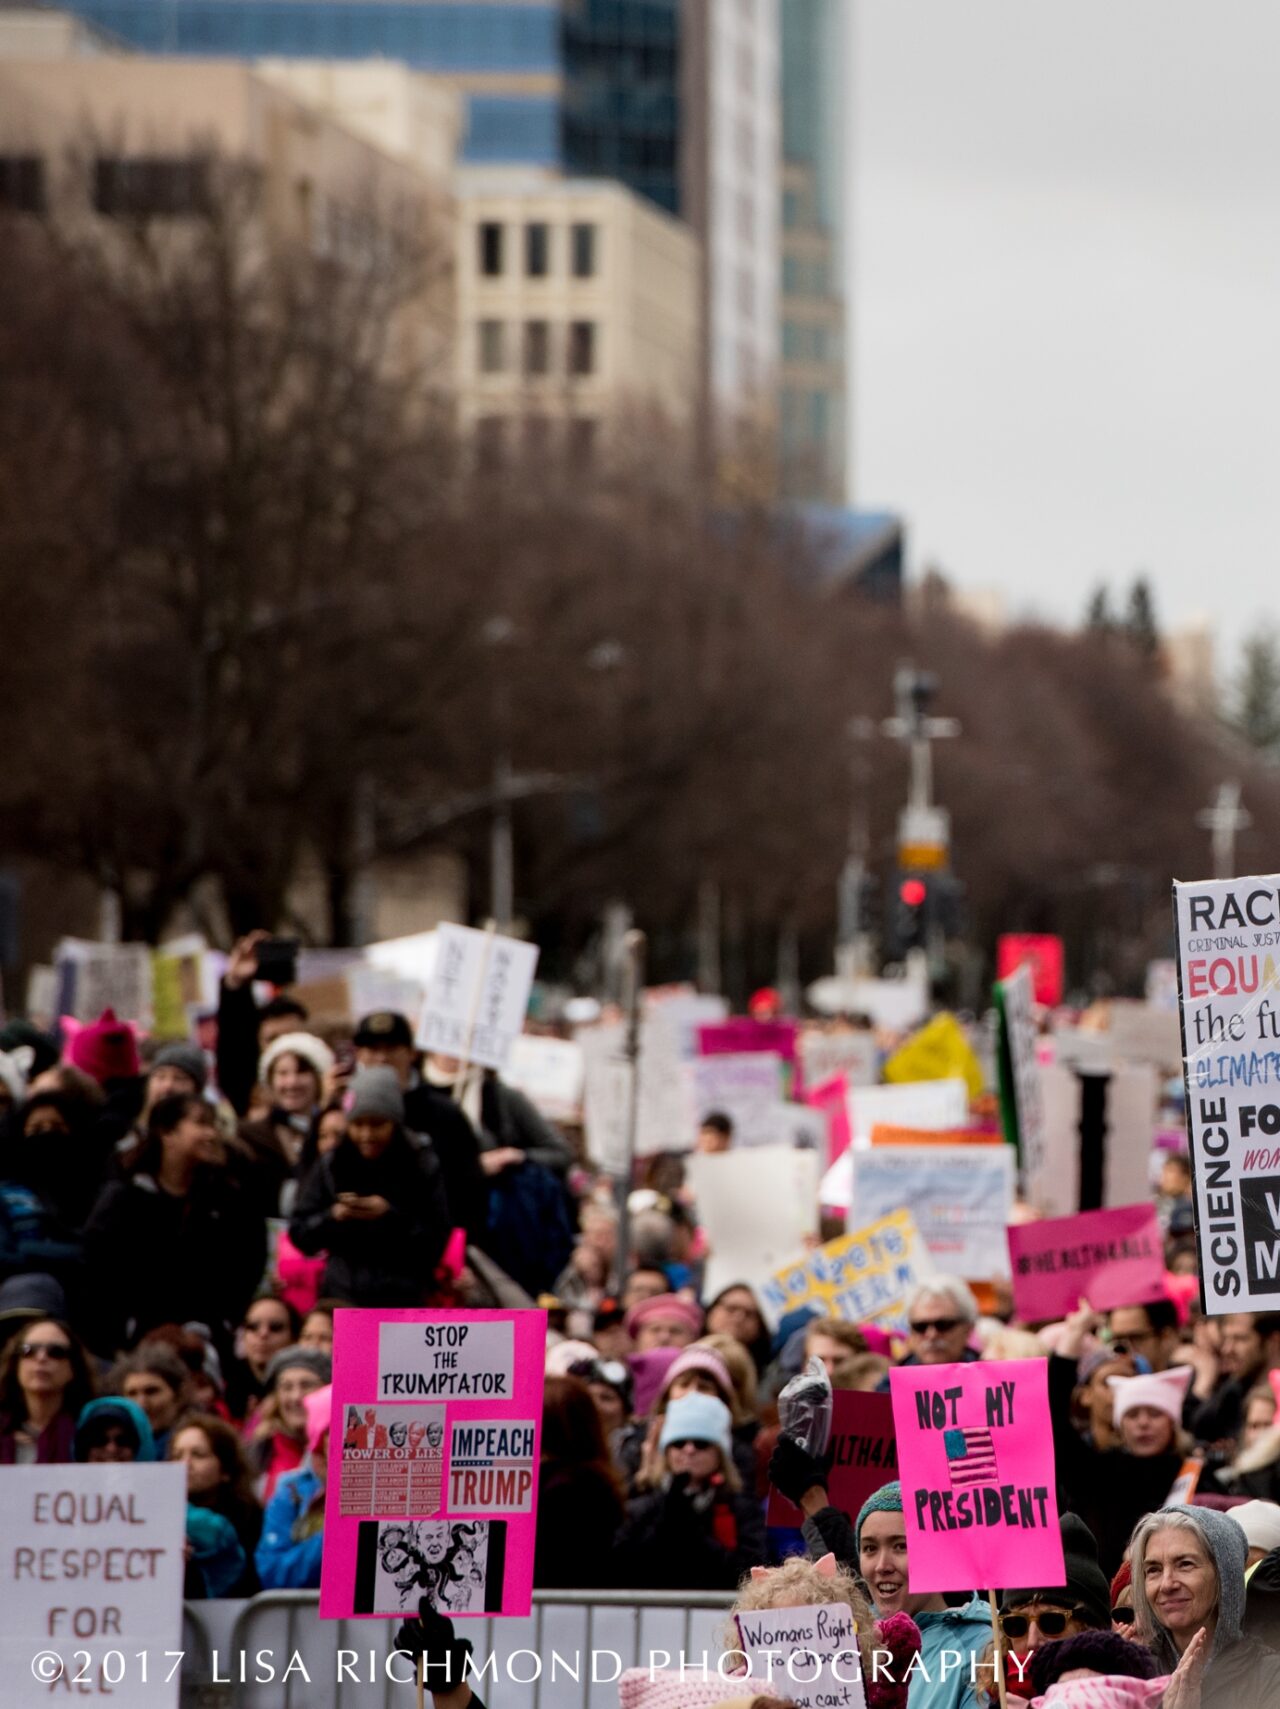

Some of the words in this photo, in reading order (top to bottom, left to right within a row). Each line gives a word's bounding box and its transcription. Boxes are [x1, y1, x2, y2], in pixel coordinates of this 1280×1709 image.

[1188, 934, 1248, 953] CRIMINAL
[1193, 1003, 1247, 1045] the
[1200, 1097, 1241, 1297] SCIENCE
[424, 1325, 469, 1347] STOP
[432, 1351, 459, 1370] THE
[381, 1372, 507, 1395] TRUMPTATOR
[915, 1386, 963, 1430] NOT
[985, 1381, 1016, 1428] MY
[343, 1449, 391, 1460] TOWER
[394, 1448, 411, 1460] OF
[415, 1448, 443, 1459] LIES
[451, 1428, 535, 1457] IMPEACH
[450, 1470, 532, 1506] TRUMP
[33, 1490, 146, 1527] EQUAL
[914, 1484, 1048, 1532] PRESIDENT
[13, 1546, 167, 1582] RESPECT
[47, 1605, 123, 1639] FOR
[743, 1621, 814, 1648] Womans
